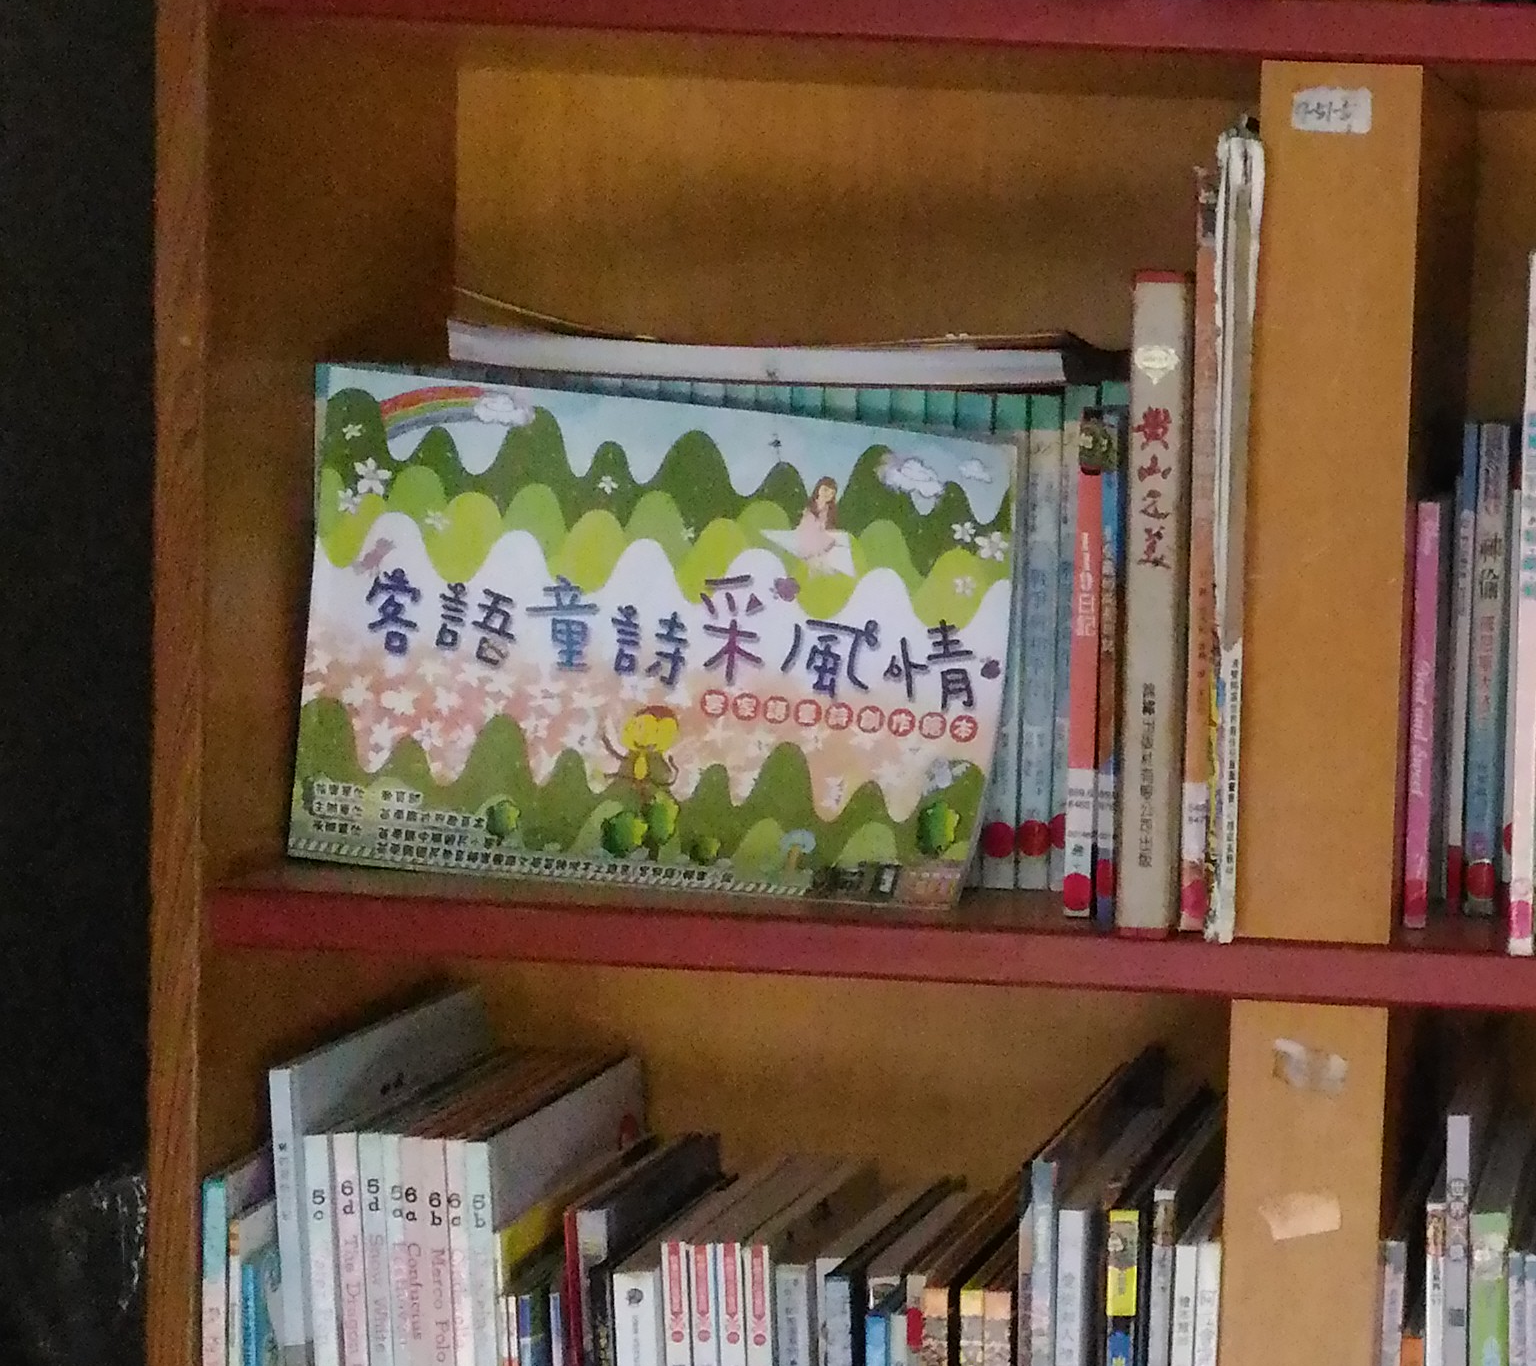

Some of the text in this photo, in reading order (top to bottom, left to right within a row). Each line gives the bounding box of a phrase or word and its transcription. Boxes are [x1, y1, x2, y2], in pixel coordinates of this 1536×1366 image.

[1133, 404, 1174, 570] 黃山之美
[406, 1241, 423, 1340] Confucius
